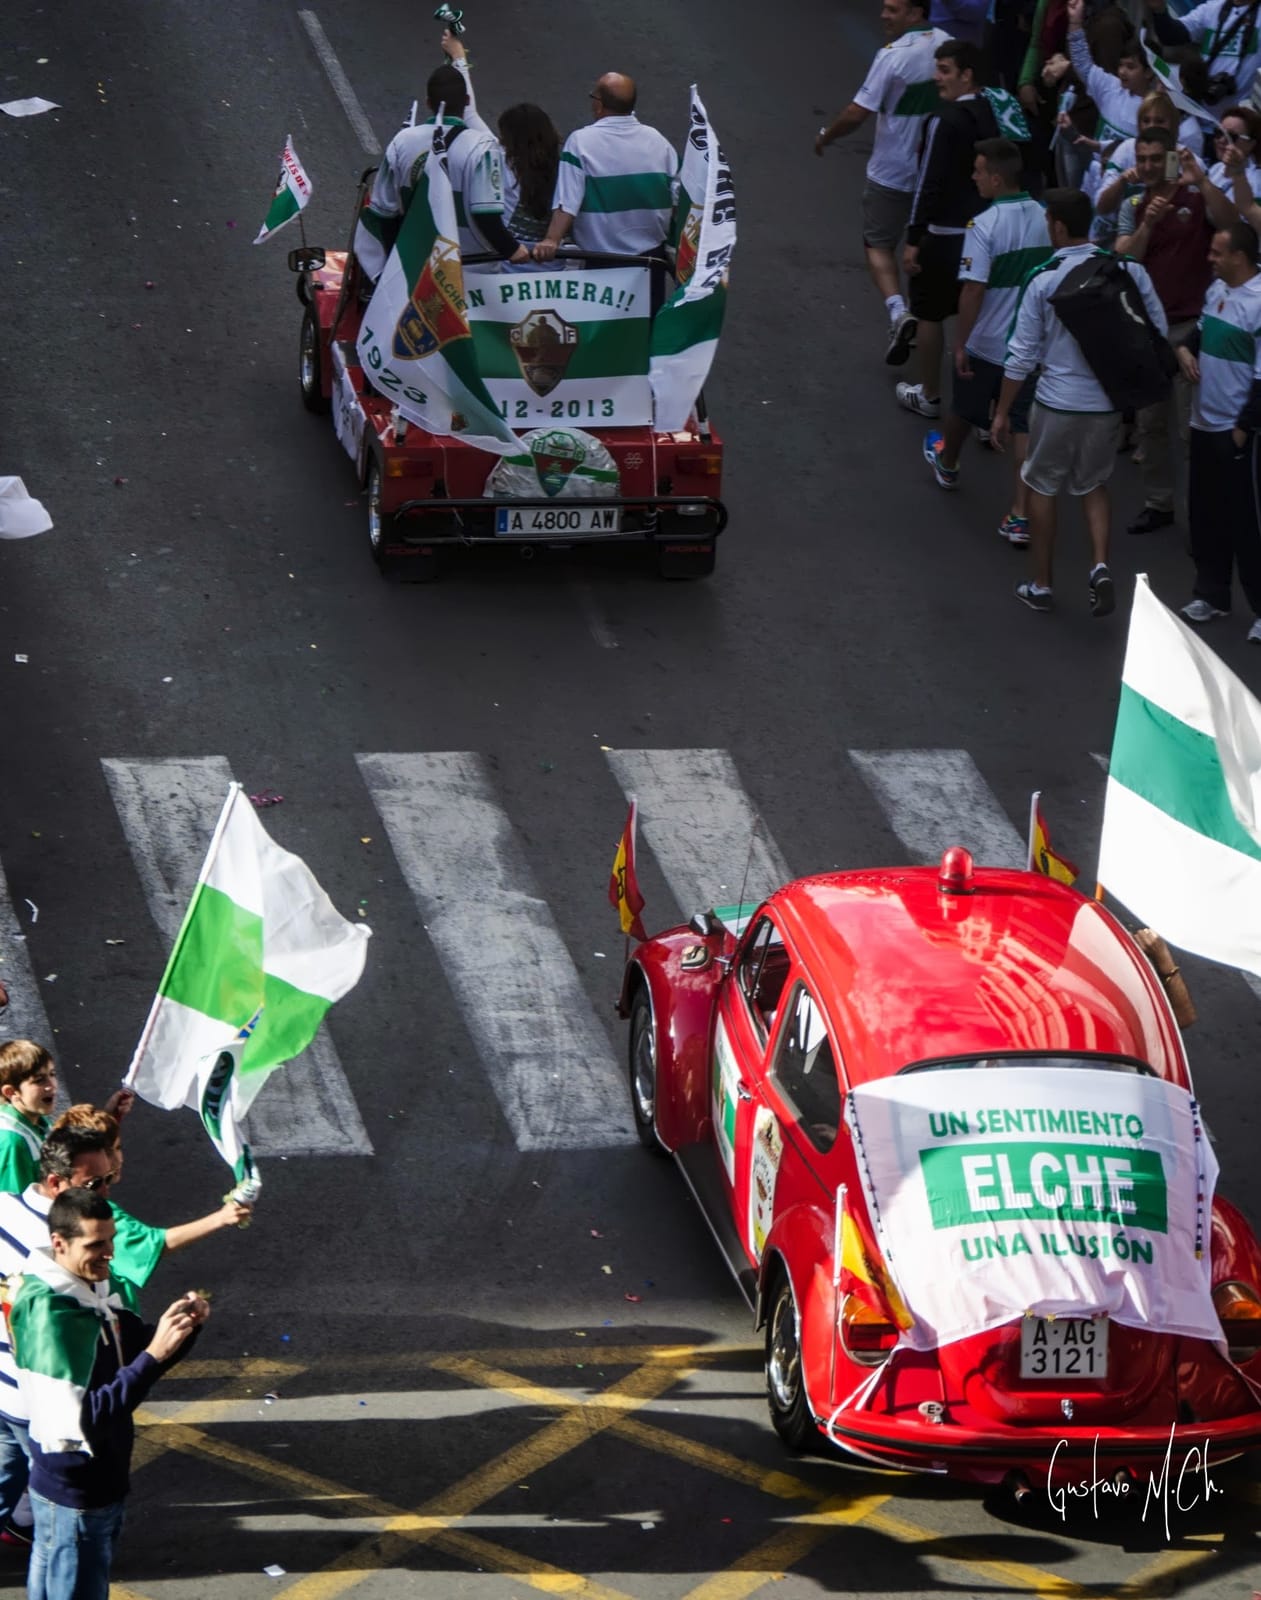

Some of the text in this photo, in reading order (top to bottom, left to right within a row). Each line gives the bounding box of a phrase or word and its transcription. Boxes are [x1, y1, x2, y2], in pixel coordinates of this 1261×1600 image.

[434, 269, 468, 311] ELCHE
[462, 278, 636, 312] N PRIMERA!!
[361, 325, 428, 405] 1923
[511, 510, 616, 530] A 4800 AW
[928, 1109, 1145, 1140] UN SENTIMIENTO
[961, 1151, 1137, 1215] ELCHE
[961, 1231, 1154, 1265] UNA ILUSIÓN
[1031, 1347, 1097, 1375] 3121
